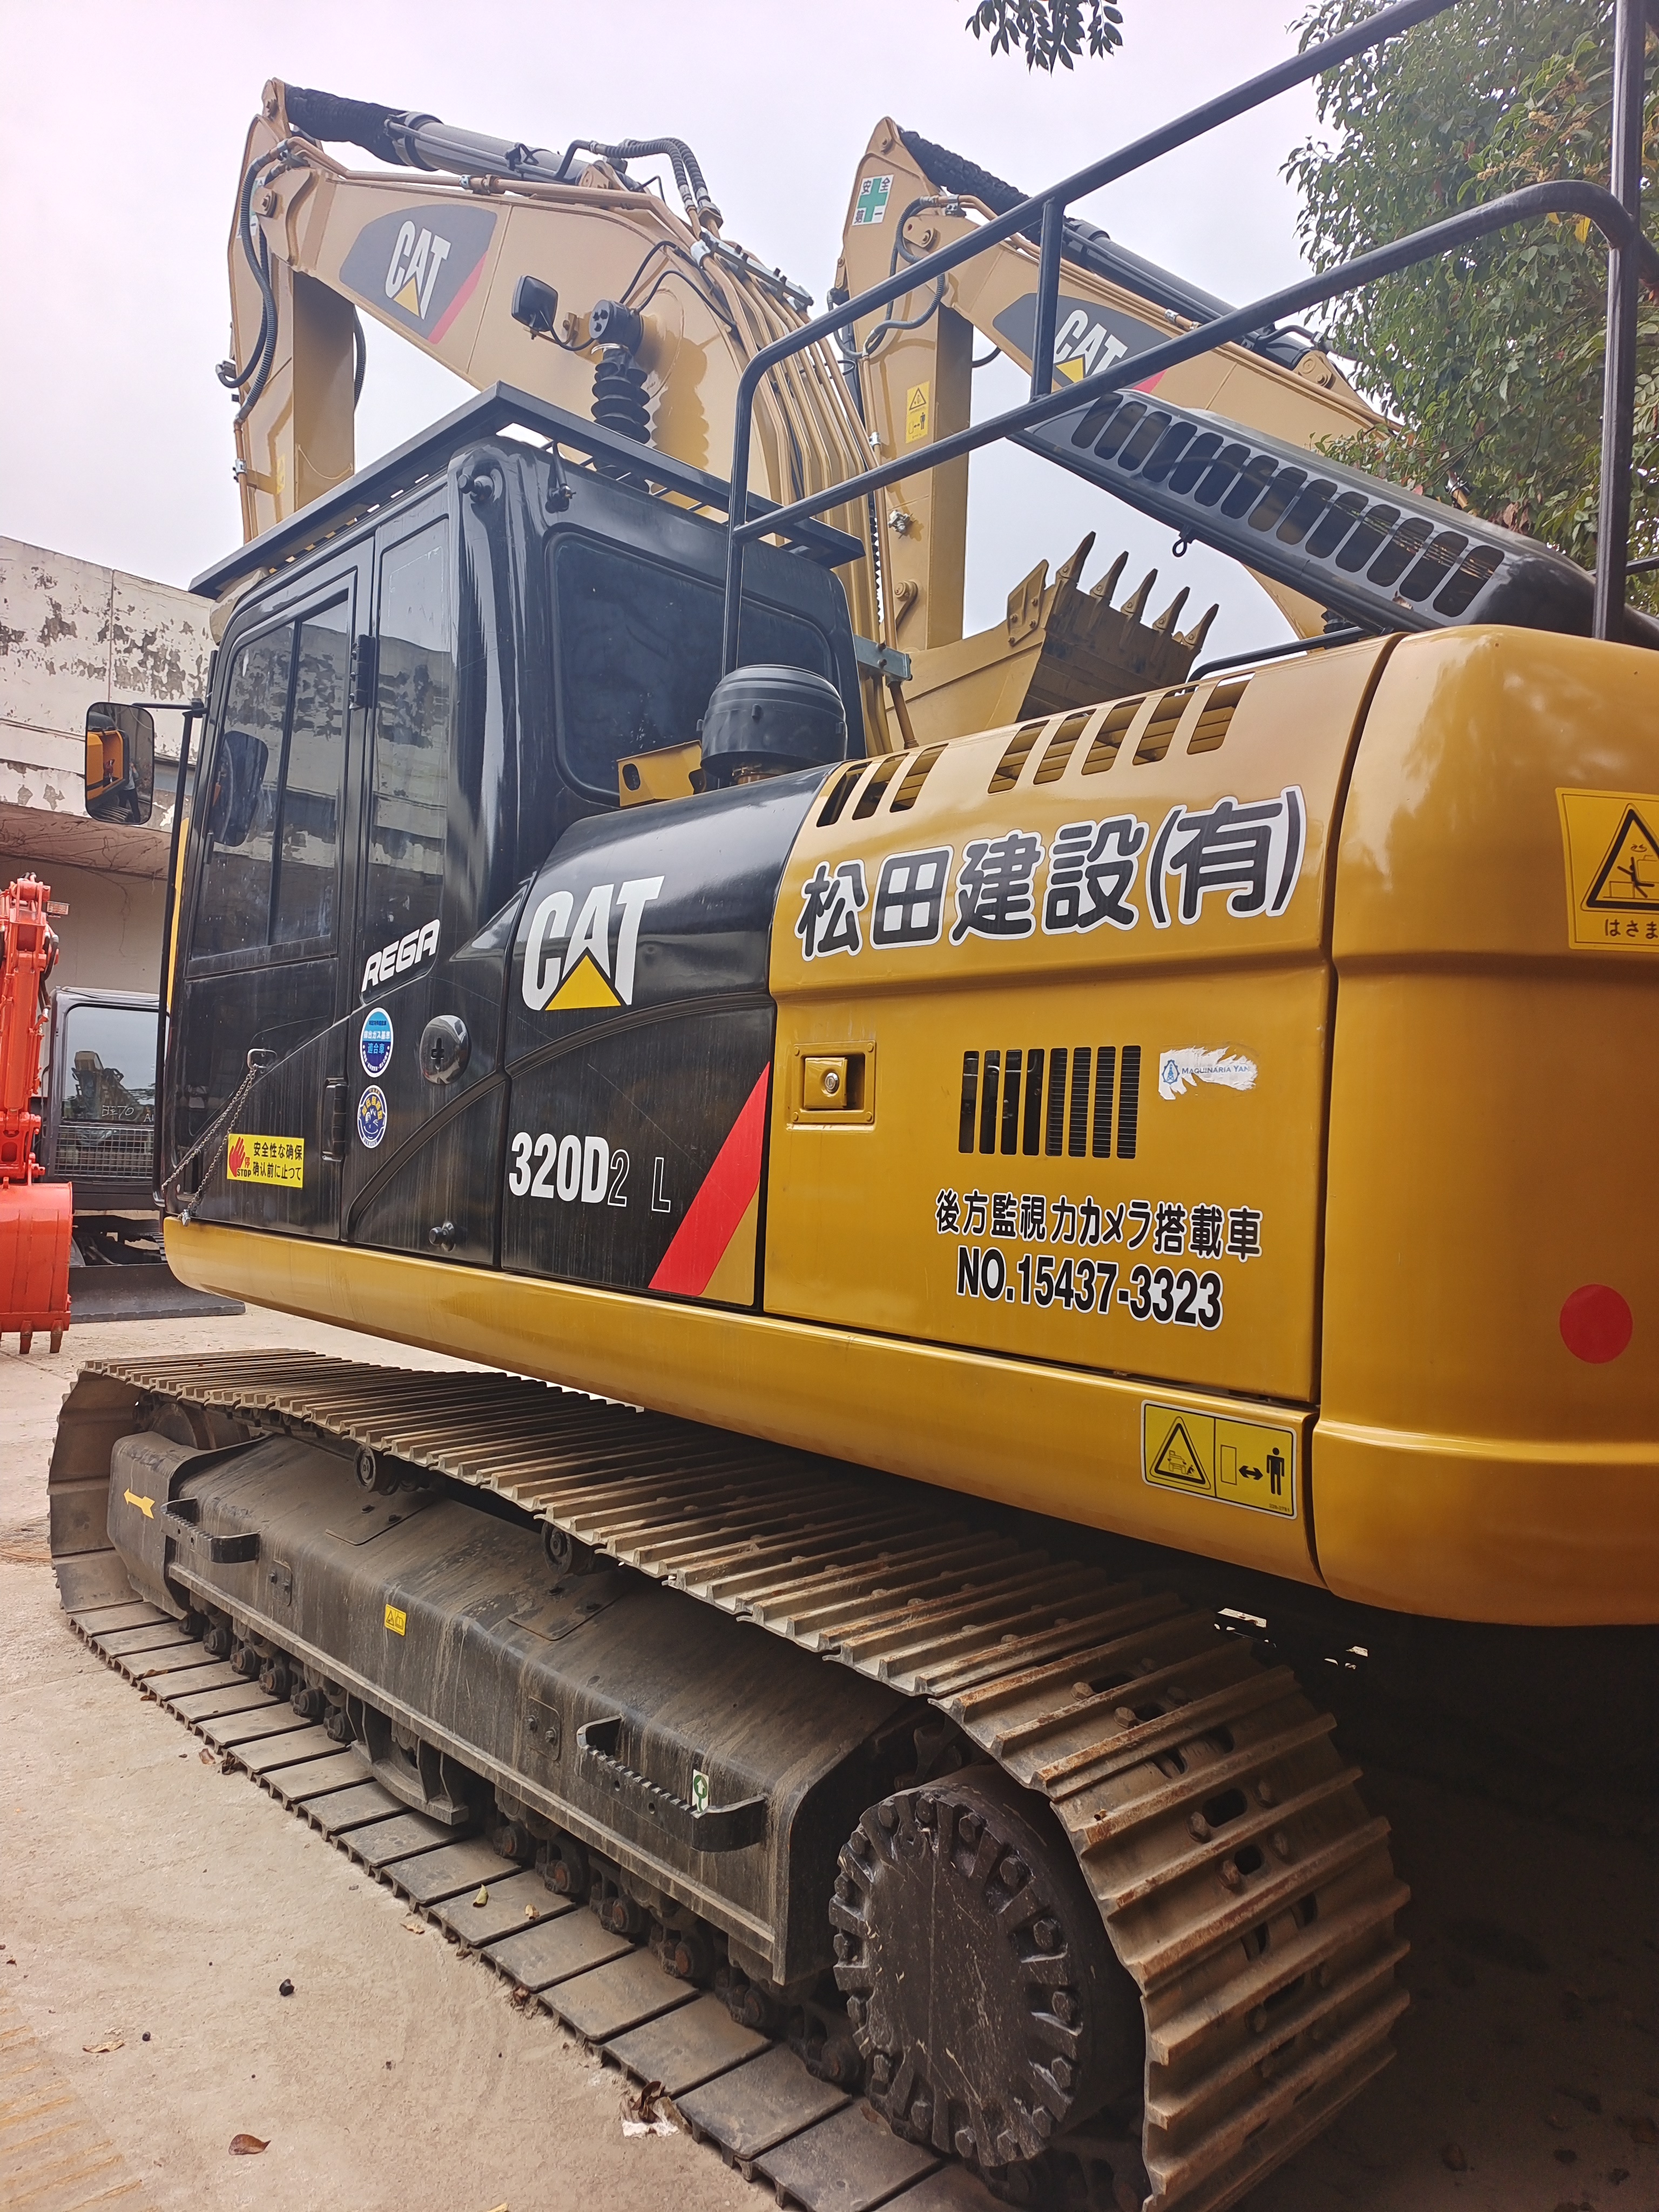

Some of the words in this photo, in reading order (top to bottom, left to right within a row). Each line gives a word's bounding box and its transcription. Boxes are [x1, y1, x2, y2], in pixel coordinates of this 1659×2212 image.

[385, 220, 451, 320] CAT
[1053, 309, 1129, 375] CAT
[361, 919, 440, 992] REGA
[522, 875, 665, 1010] CAT
[1604, 919, 1658, 939] はさま
[237, 1168, 251, 1177] STOP
[651, 1157, 671, 1212] L
[957, 1246, 1222, 1330] NO.15437-3323
